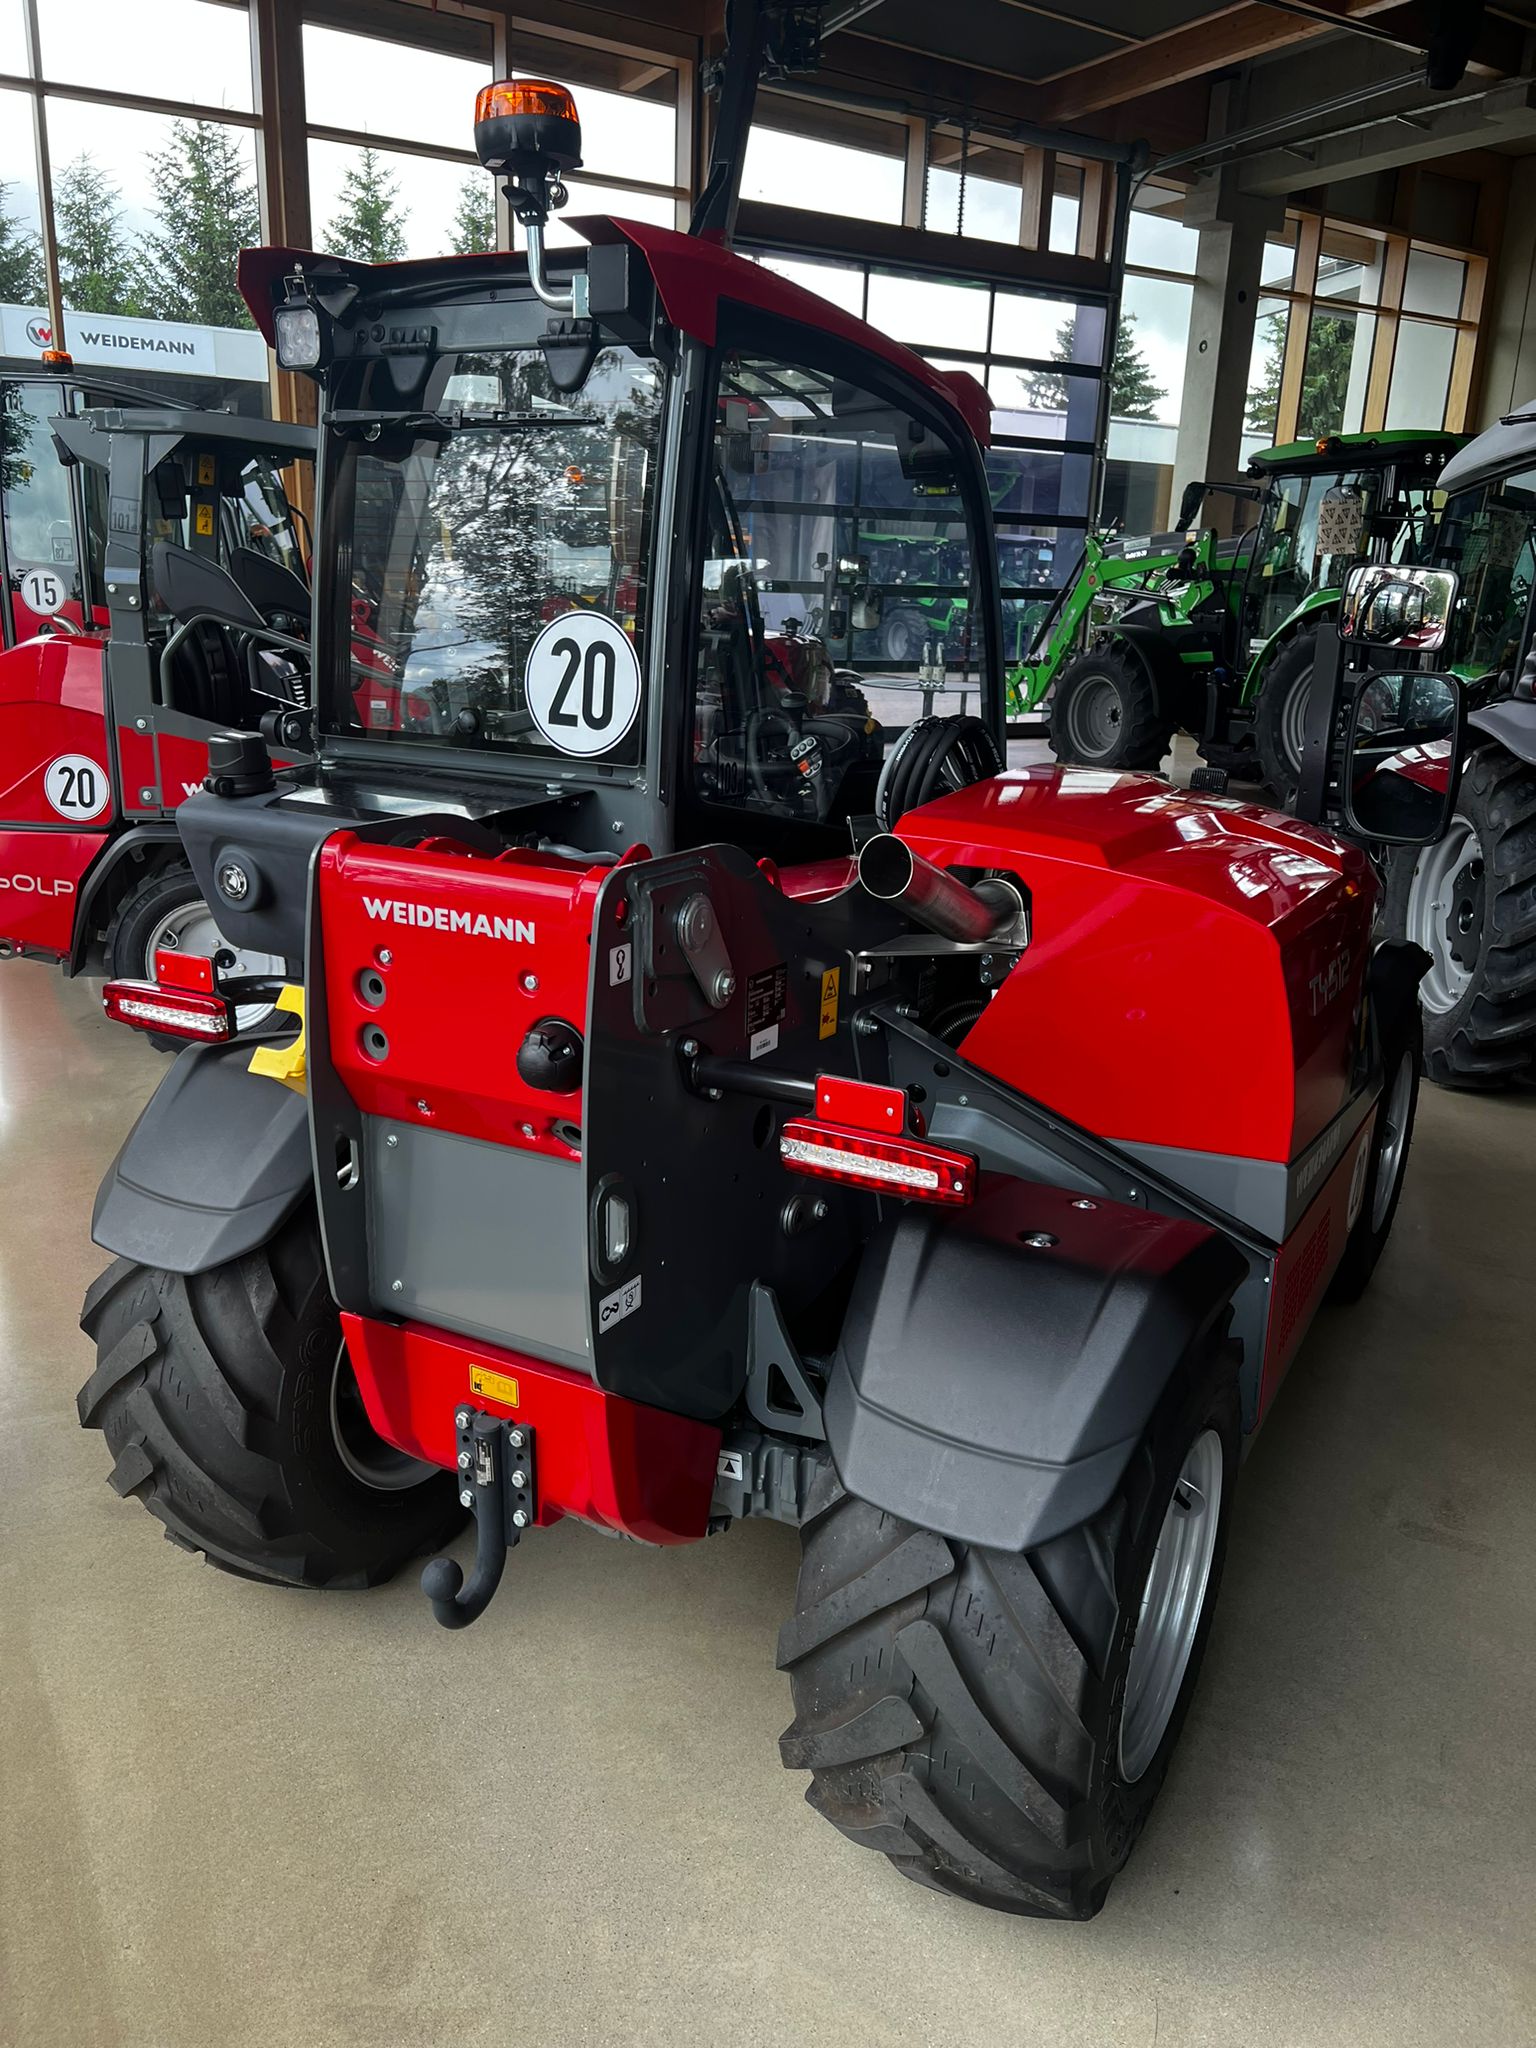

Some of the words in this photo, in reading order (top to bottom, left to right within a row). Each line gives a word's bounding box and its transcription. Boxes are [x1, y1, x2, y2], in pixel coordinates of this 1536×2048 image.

[80, 331, 195, 355] WEIDEMANN
[31, 576, 57, 606] 15
[548, 637, 616, 730] 20
[58, 766, 96, 810] 20
[362, 896, 536, 945] WEIDEMANN
